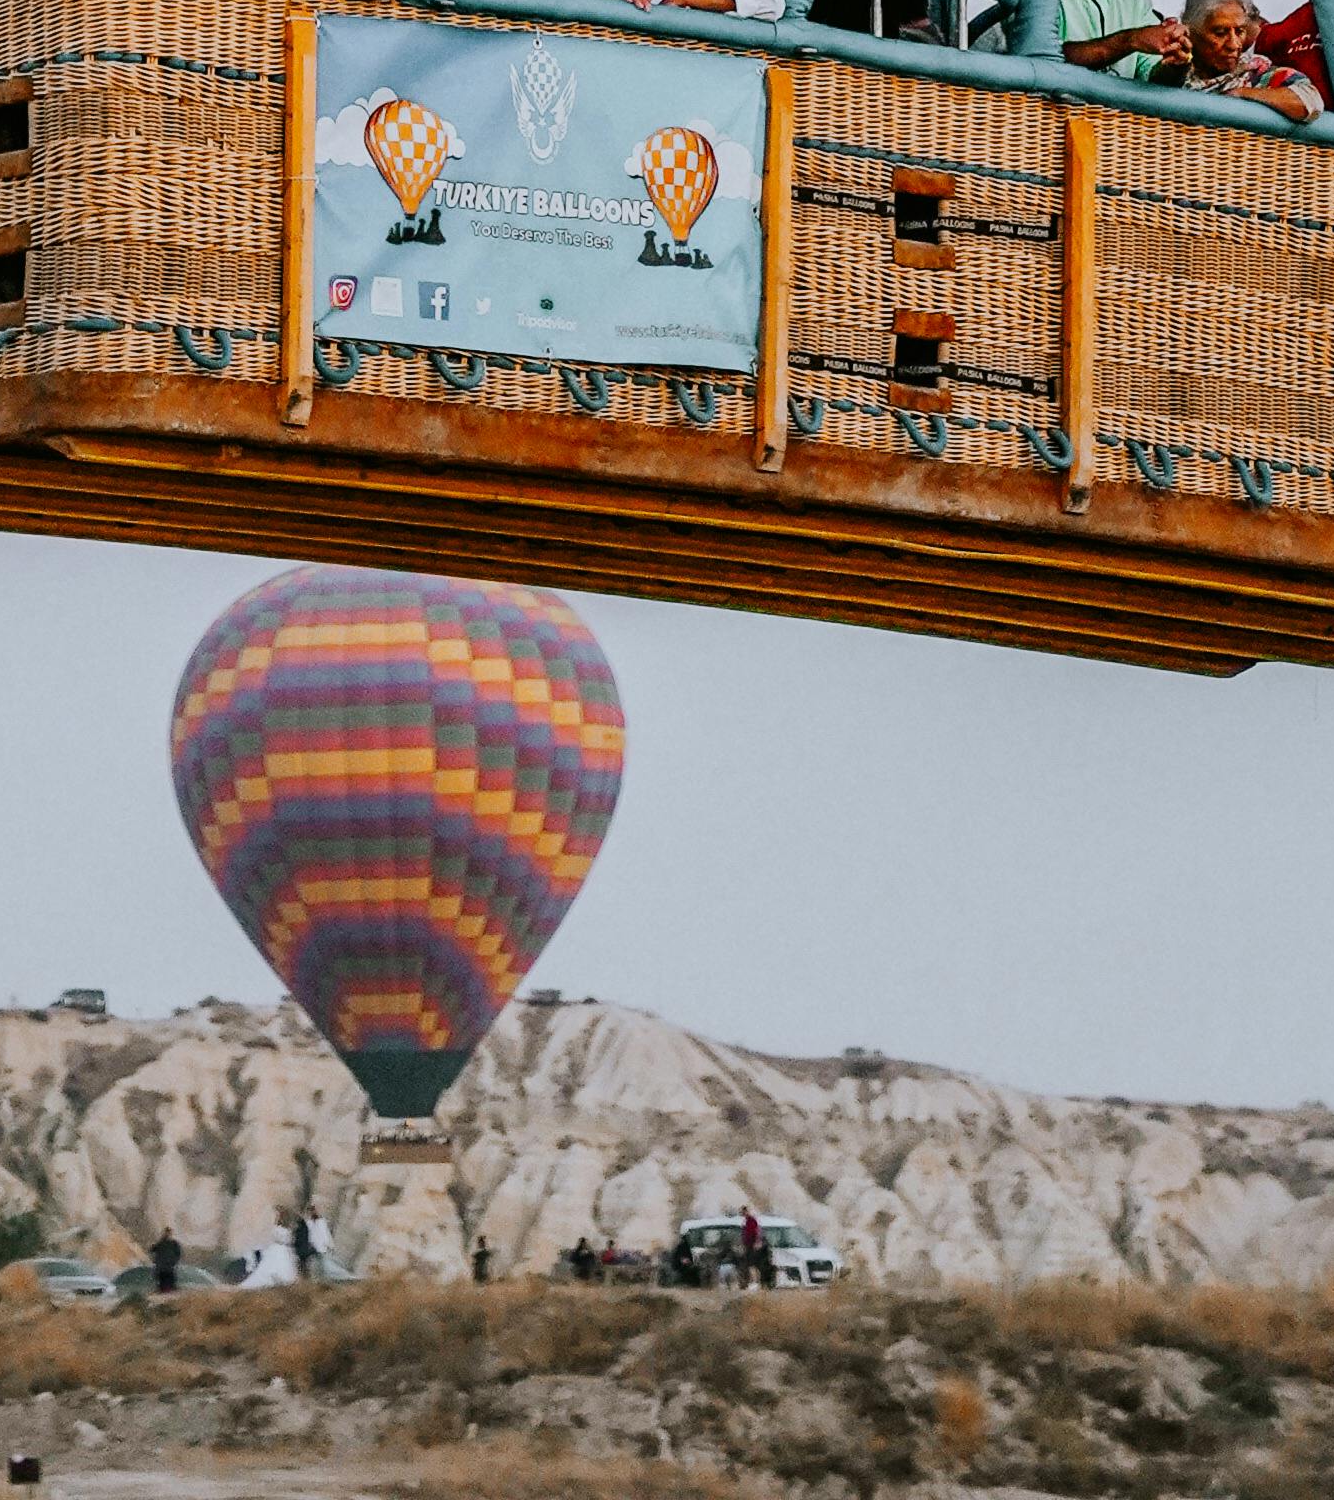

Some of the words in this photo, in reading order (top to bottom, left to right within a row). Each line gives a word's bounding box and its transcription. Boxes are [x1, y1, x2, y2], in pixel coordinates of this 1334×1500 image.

[432, 179, 529, 214] TURKIYE
[532, 189, 656, 227] BALLOONS
[471, 220, 500, 237] You
[503, 224, 554, 244] Deserve
[556, 228, 582, 247] The
[584, 231, 613, 250] Best
